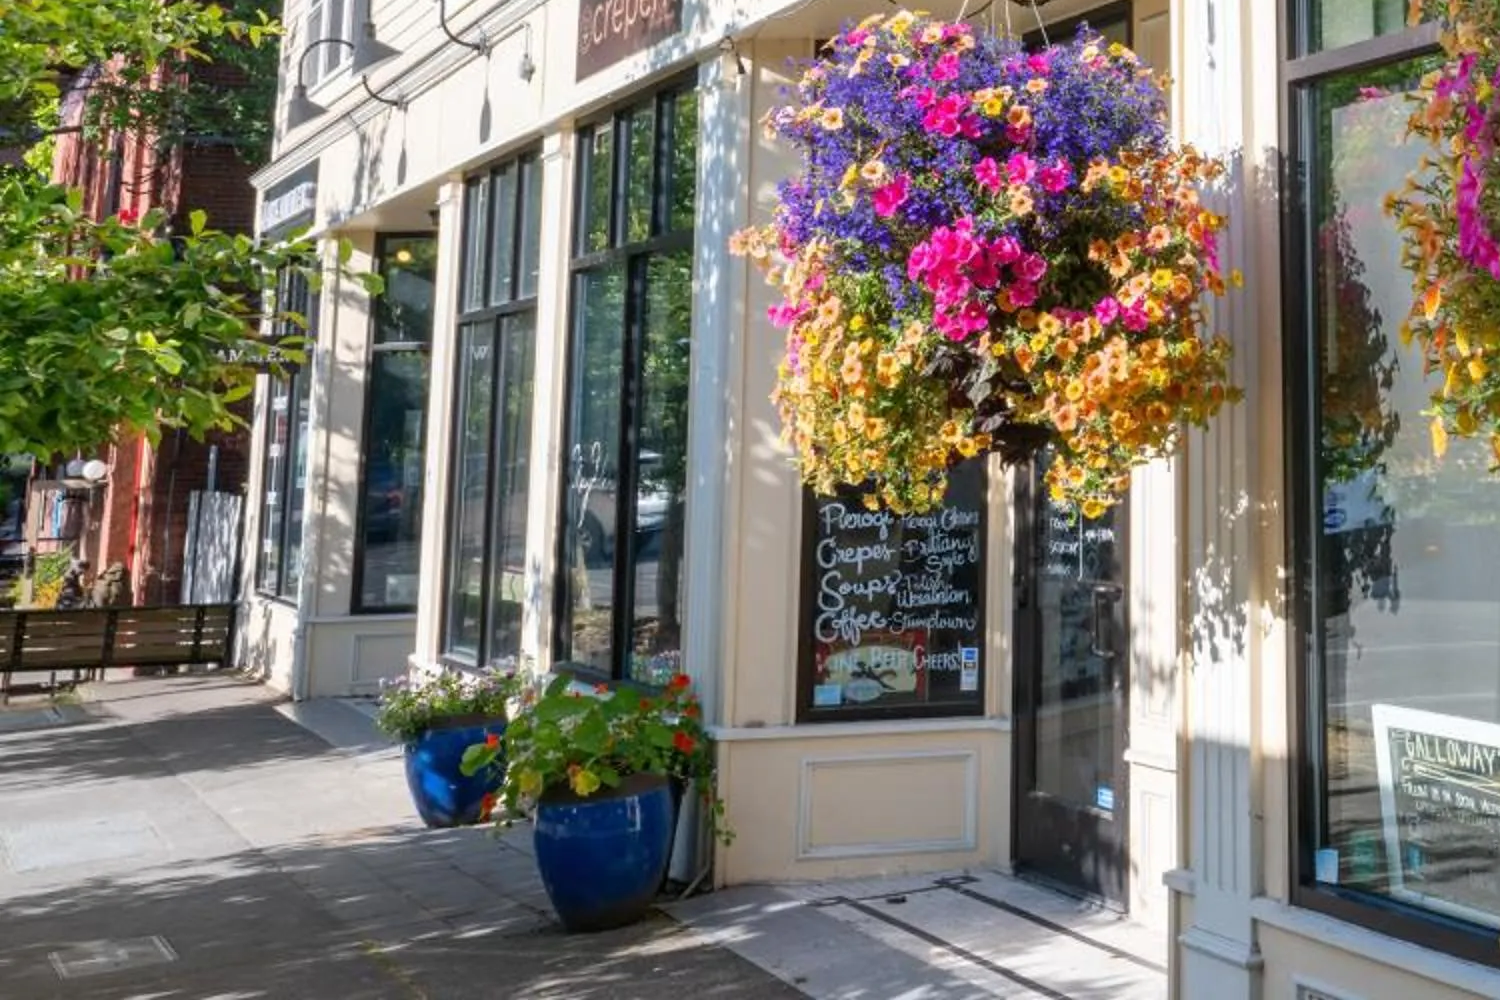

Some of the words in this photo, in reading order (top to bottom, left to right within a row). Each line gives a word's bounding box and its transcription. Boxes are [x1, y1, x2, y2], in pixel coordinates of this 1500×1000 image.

[816, 536, 894, 576] Crepes
[818, 569, 902, 612] Soups
[815, 605, 888, 647] Coffee
